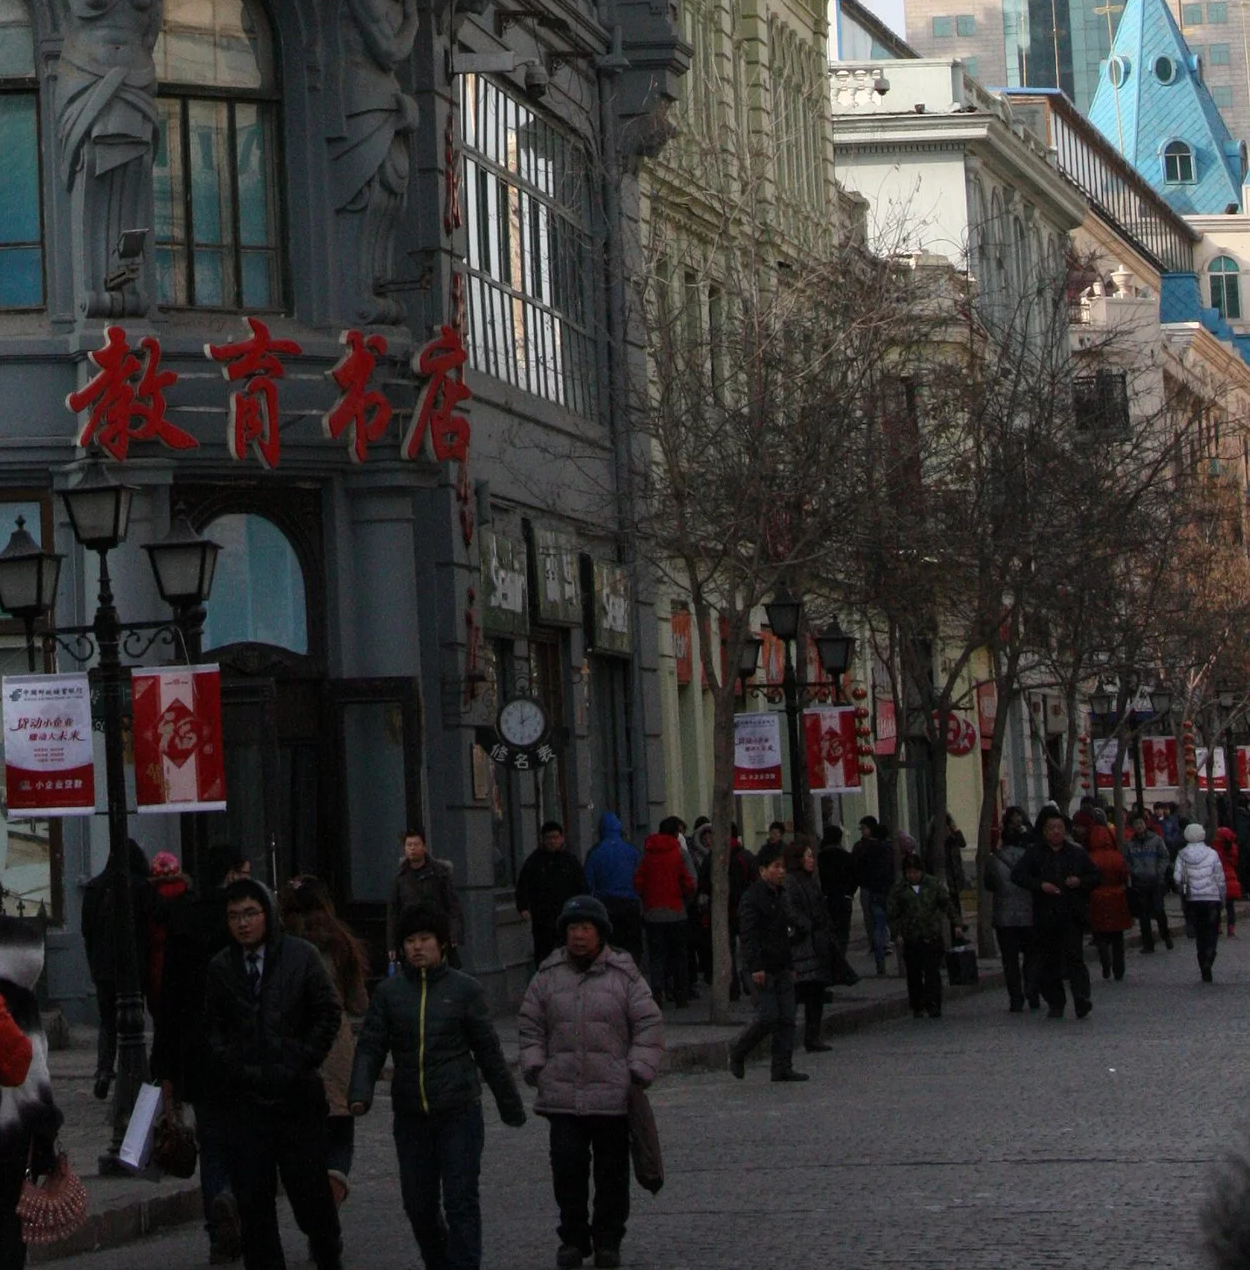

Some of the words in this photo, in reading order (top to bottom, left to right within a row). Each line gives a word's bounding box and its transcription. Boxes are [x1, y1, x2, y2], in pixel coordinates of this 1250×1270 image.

[65, 317, 473, 469] 教育书店
[490, 742, 556, 769] 修名表
